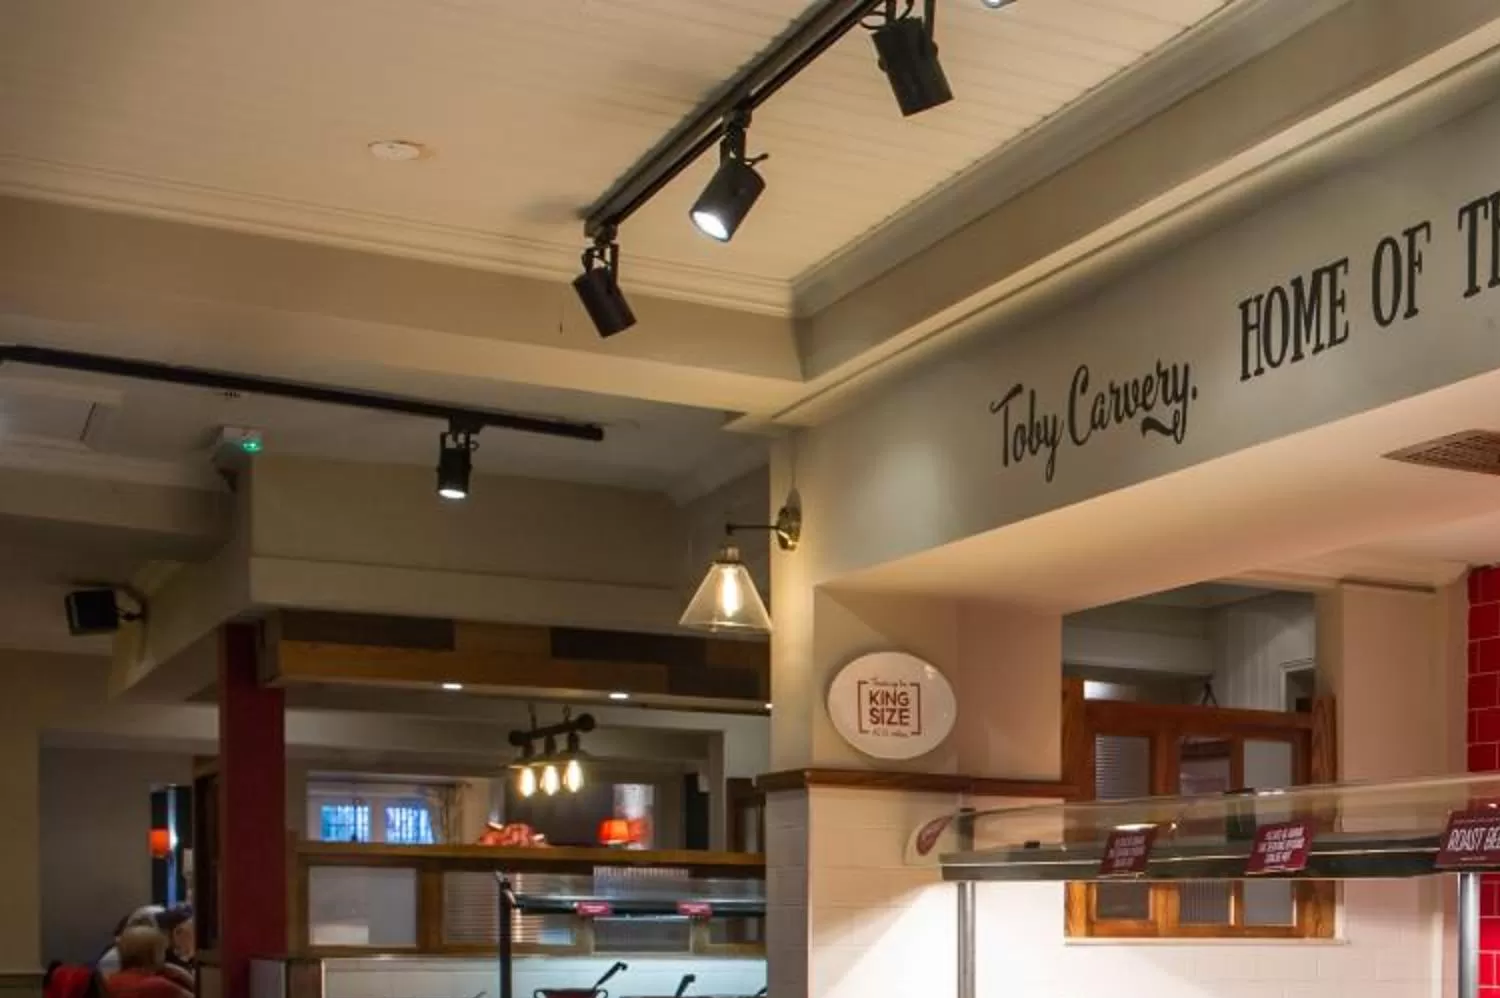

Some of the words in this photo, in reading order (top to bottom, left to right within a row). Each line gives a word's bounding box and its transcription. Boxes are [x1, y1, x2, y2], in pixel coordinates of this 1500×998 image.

[1237, 256, 1350, 382] HOME
[1371, 219, 1432, 328] OF
[989, 383, 1065, 484] Toby
[868, 688, 911, 707] KING
[868, 706, 911, 727] SIZE
[1446, 827, 1487, 853] ROAST
